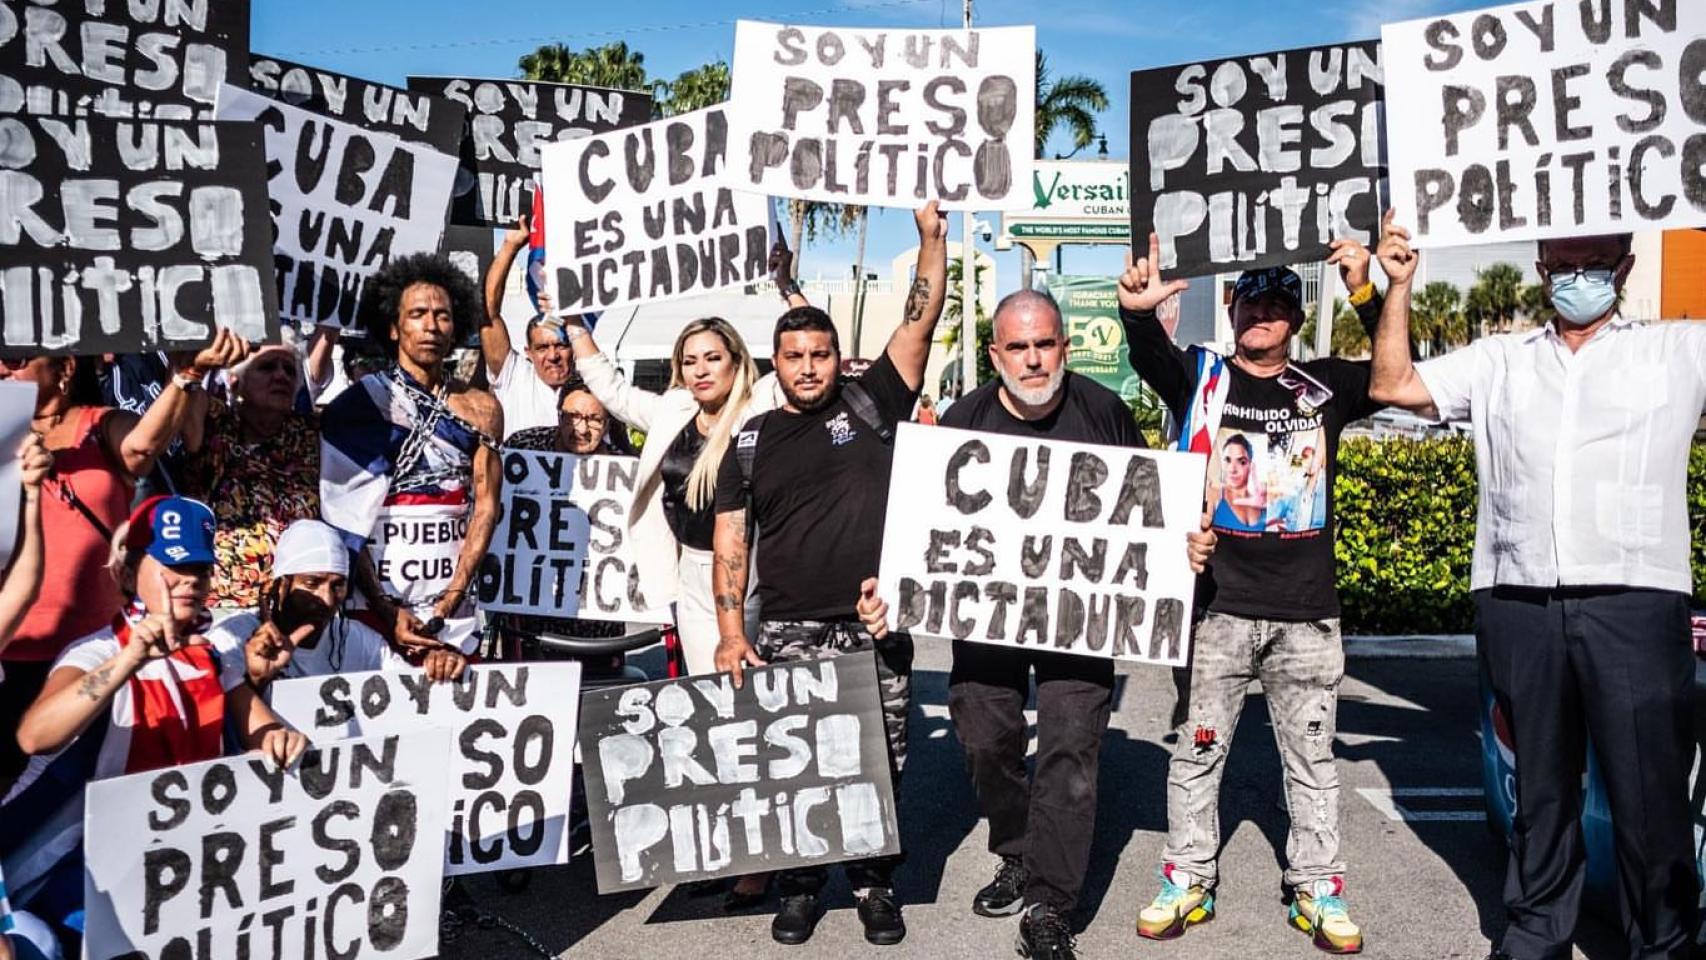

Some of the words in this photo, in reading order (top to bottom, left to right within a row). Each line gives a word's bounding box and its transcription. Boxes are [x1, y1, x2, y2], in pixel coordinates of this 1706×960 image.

[773, 26, 888, 69] SOY
[903, 31, 980, 69] UN
[1424, 4, 1555, 72] SOY
[1579, 0, 1677, 45] UN
[250, 59, 347, 116] SOY
[363, 86, 430, 132] UN
[443, 79, 538, 120] SOY
[554, 87, 624, 126] UN
[781, 74, 1018, 140] PRESO
[1174, 54, 1287, 116] SOY
[1308, 44, 1386, 96] UN
[1441, 38, 1706, 157] PRESO
[116, 121, 219, 171] UN
[578, 109, 729, 205] CUBA
[298, 208, 396, 271] UNA
[574, 210, 625, 259] ES
[643, 187, 738, 241] UNA
[1083, 205, 1124, 215] CUBAN
[556, 226, 767, 311] DICTADURA
[1223, 403, 1291, 421] ROHIBIDO
[579, 457, 638, 493] UN
[945, 439, 1165, 528] CUBA
[384, 519, 467, 545] PUEBLO
[496, 496, 625, 554] RES
[925, 526, 996, 576] ES
[1021, 535, 1149, 591] UNA
[401, 558, 459, 582] CUB
[897, 577, 1184, 660] DICTADURA
[315, 674, 433, 728] SOY
[453, 667, 529, 712] UN
[615, 674, 735, 736] SOY
[753, 660, 839, 713] UN
[149, 760, 286, 832] SOY
[299, 734, 400, 800] UN
[459, 714, 554, 791] SO
[599, 714, 861, 805] PRESO
[143, 789, 418, 936] PRESO
